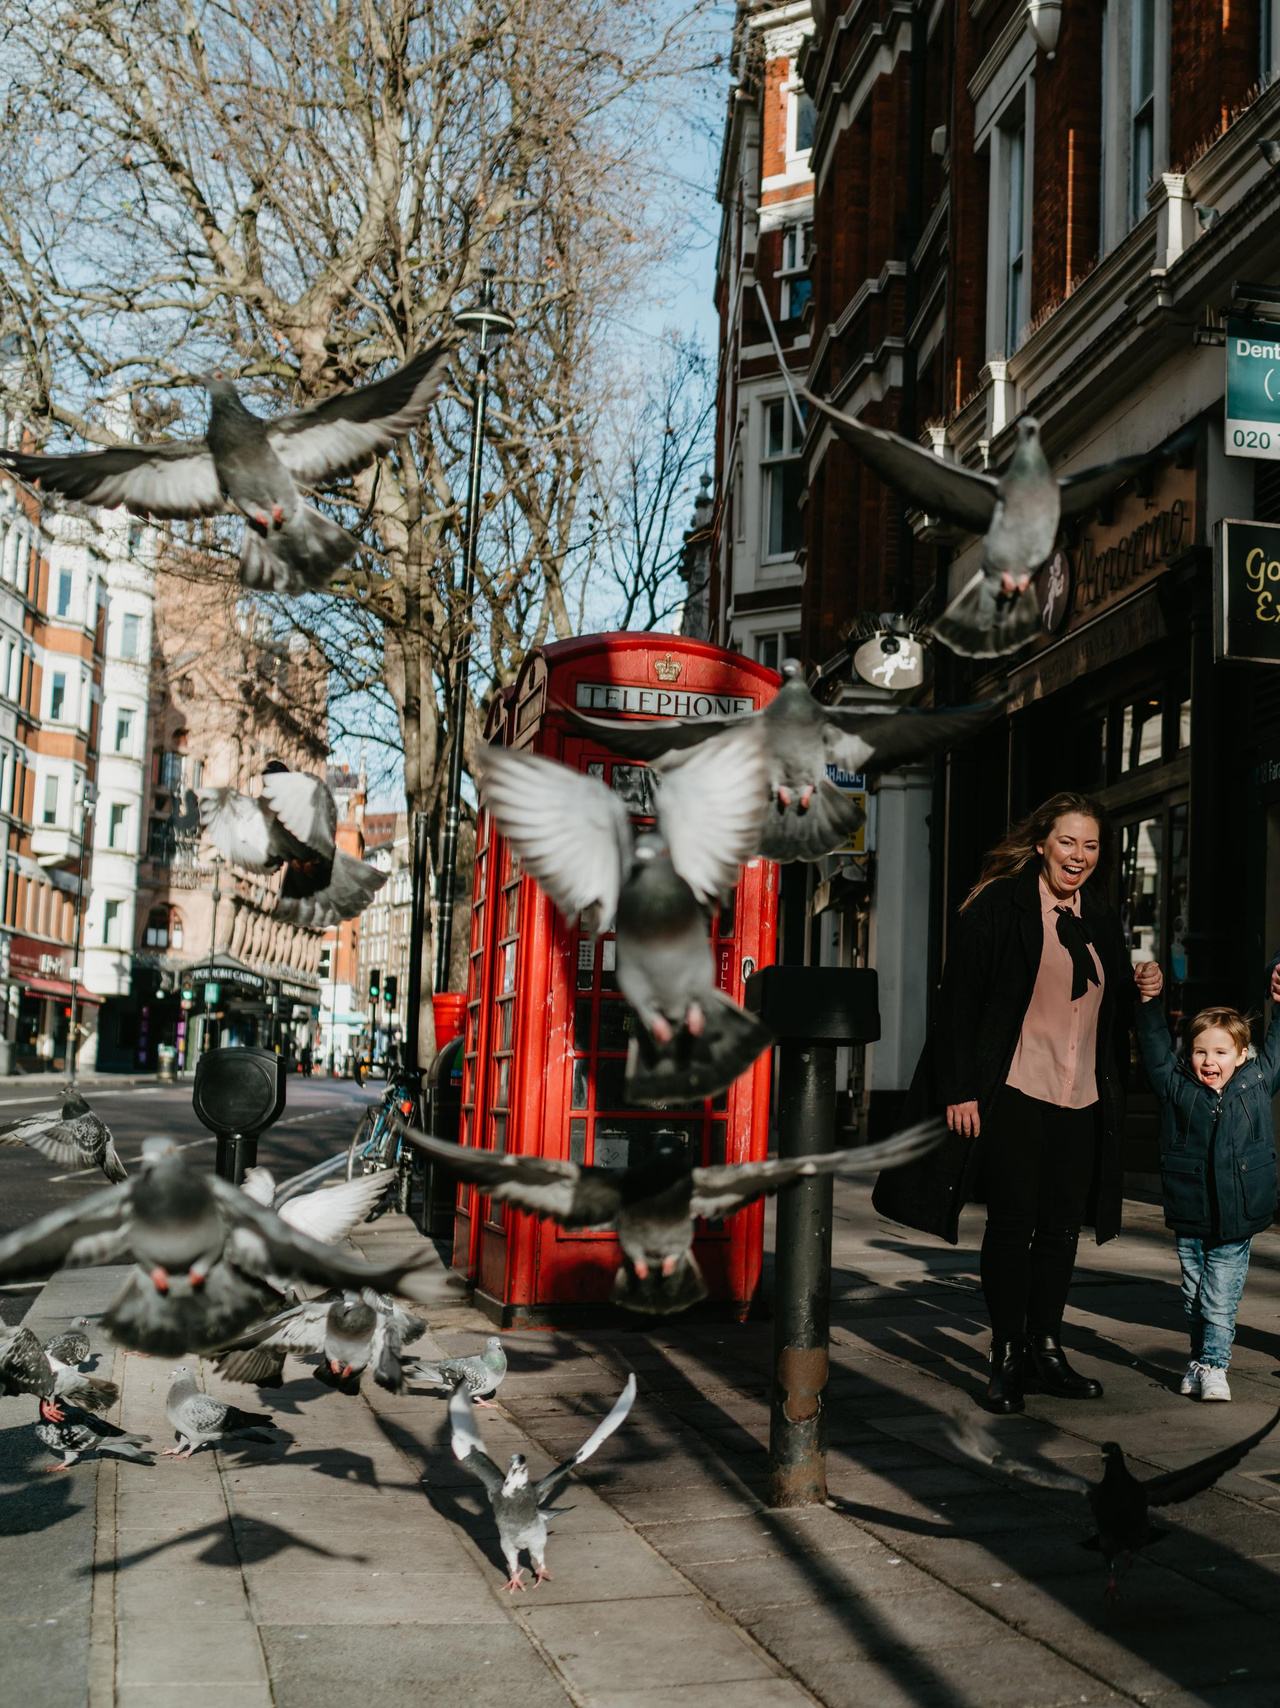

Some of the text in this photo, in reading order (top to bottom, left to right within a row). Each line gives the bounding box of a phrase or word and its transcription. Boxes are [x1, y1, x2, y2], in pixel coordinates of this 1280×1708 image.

[1233, 429, 1271, 450] 020
[583, 685, 747, 717] TELEPHONE
[825, 764, 863, 783] HANGE
[720, 952, 729, 990] PULL
